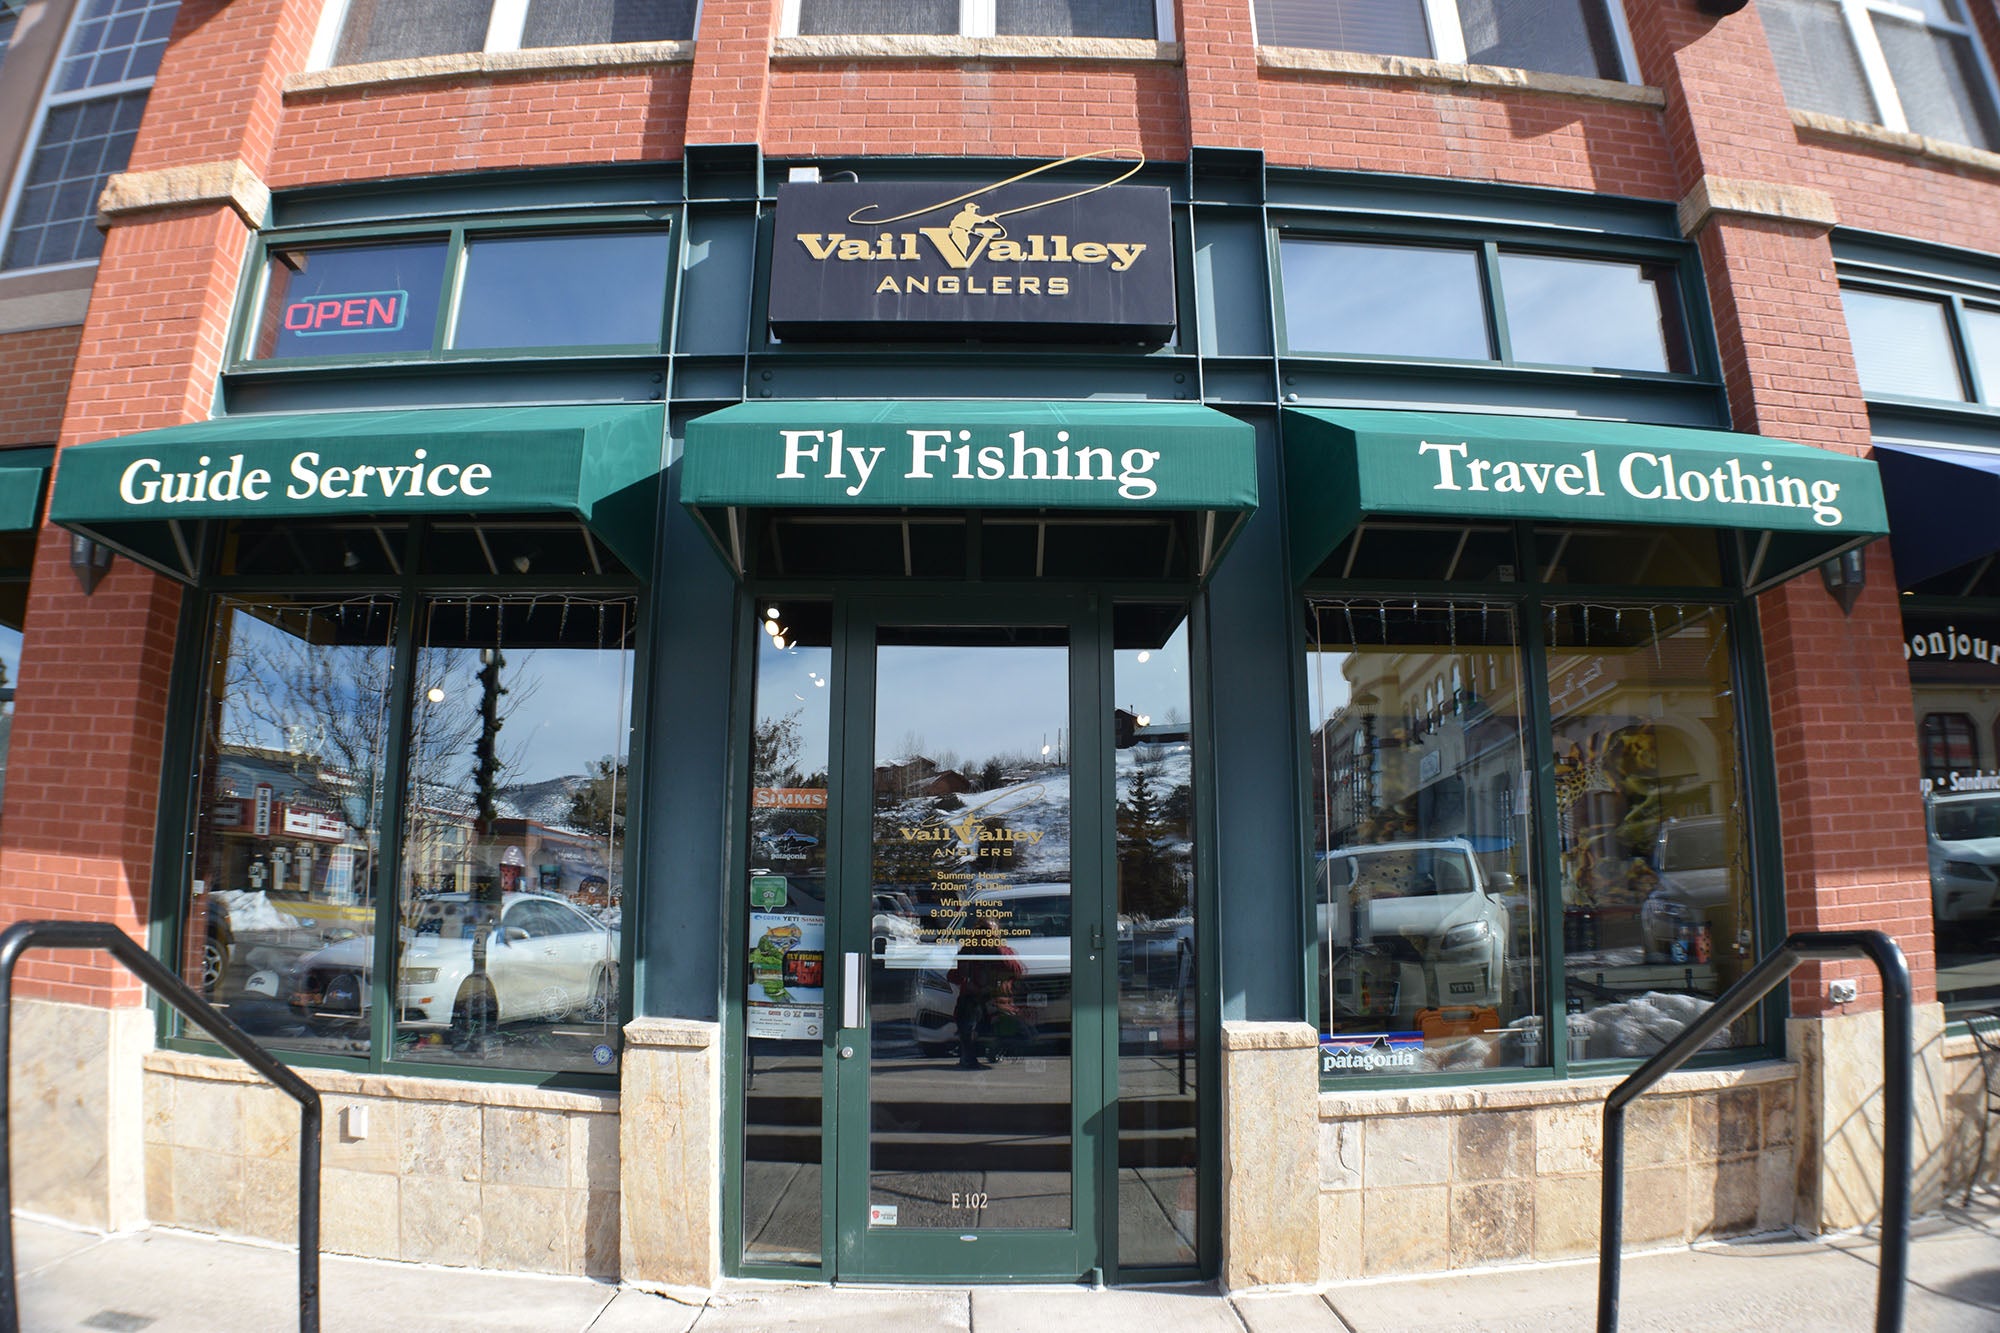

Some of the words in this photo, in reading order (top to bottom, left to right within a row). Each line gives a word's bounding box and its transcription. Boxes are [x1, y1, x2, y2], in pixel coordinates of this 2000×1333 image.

[797, 233, 920, 260] Vail
[919, 228, 1146, 271] Valley
[876, 276, 1069, 295] ANGLERS
[285, 297, 396, 330] OPEN
[776, 429, 886, 496] Fly
[904, 429, 1160, 500] Fishing
[120, 453, 271, 504] Guide
[286, 448, 492, 499] Service
[1418, 440, 1605, 496] Travel
[1618, 451, 1842, 526] Clothing
[1949, 769, 2000, 791] Sandwic
[756, 791, 823, 805] SIMMS
[900, 828, 951, 841] Vail
[952, 825, 1045, 845] Valley
[933, 848, 1013, 857] ANGLERS
[937, 871, 975, 880] Summer
[978, 872, 1007, 880] Hours
[931, 882, 967, 891] 7:00am
[976, 882, 1012, 892] 6:00pm
[940, 898, 971, 907] Winter
[975, 898, 1003, 907] Hours
[931, 910, 967, 918] 9:00am
[976, 910, 1013, 919] 5:00pm
[913, 928, 1031, 937] www.vailvalleyanglers.com
[1323, 1051, 1414, 1072] patagonia
[952, 1193, 960, 1208] E
[965, 1193, 988, 1208] 102
